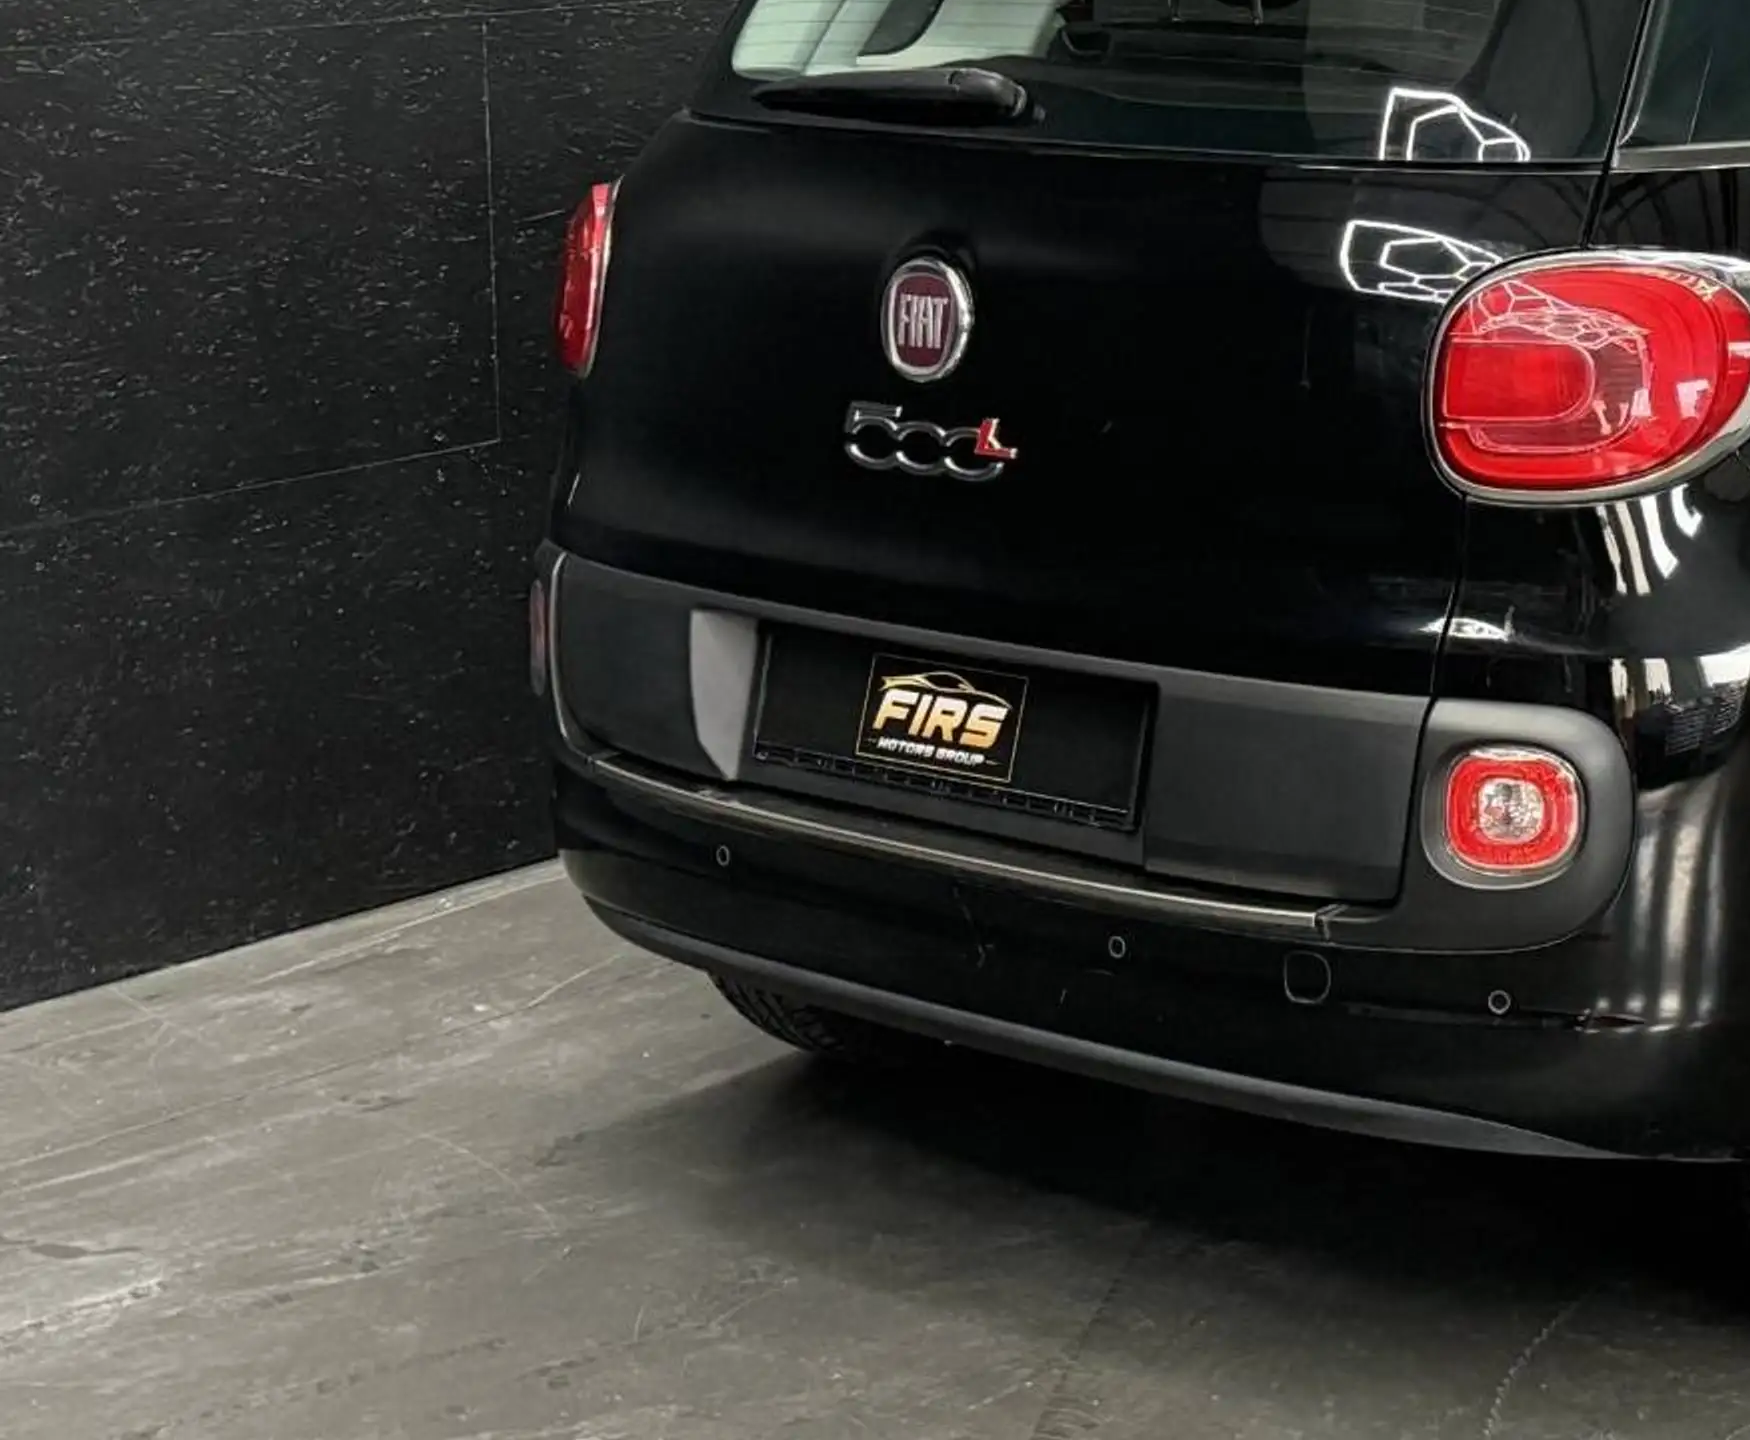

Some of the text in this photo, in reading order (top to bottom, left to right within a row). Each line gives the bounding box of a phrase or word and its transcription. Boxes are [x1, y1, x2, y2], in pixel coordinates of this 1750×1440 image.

[899, 294, 948, 349] FIAT
[845, 401, 1018, 482] 500L
[872, 689, 1008, 748] FIRS
[877, 736, 986, 766] MOTORS GROUP
